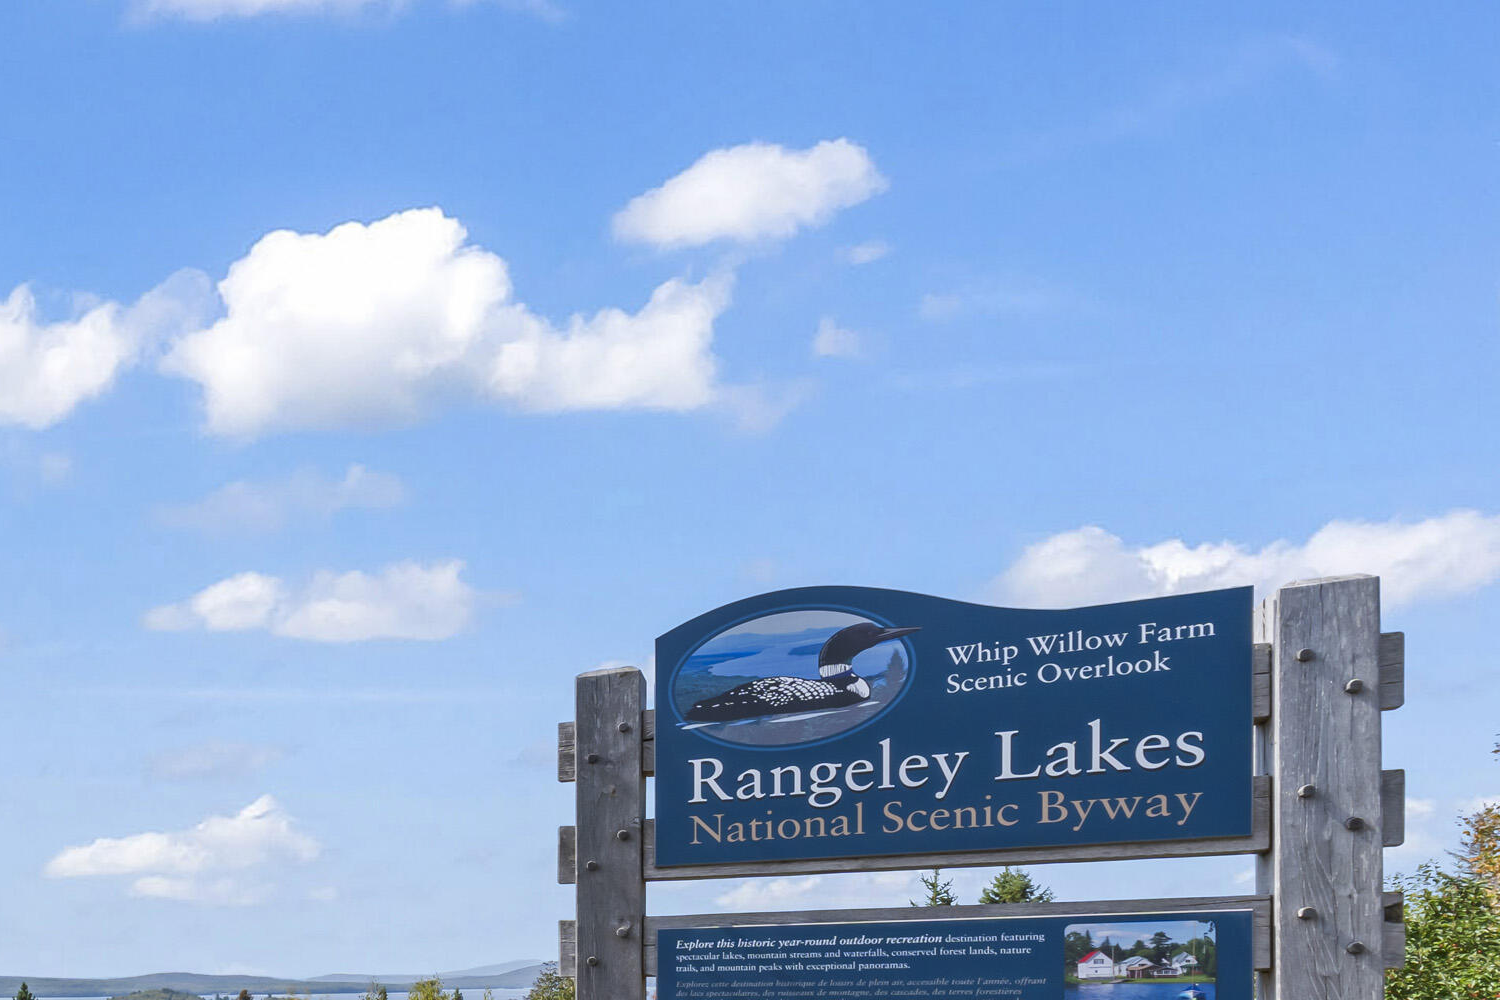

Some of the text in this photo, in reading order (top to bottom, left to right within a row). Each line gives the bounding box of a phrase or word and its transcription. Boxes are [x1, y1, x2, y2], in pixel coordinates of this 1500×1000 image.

[946, 621, 1216, 665] Whip Willow Farm
[947, 651, 1170, 693] Scenic Overlook
[688, 718, 1204, 808] Rangeley Lakes
[690, 791, 1203, 844] National Scenic Byway
[676, 932, 1046, 950] Explore this historic year-round outdoor recreation destination featuring
[676, 952, 720, 962] spectacular
[723, 952, 745, 960] lakes,
[748, 951, 786, 959] mountain
[843, 948, 889, 957] waterfalls,
[891, 947, 936, 956] conserved
[940, 947, 965, 955] forest
[970, 946, 997, 955] lands,
[676, 964, 698, 972] trails,
[759, 963, 782, 972] peaks
[785, 962, 803, 970] with
[806, 961, 855, 971] exceptional
[859, 963, 910, 971] panoramas.
